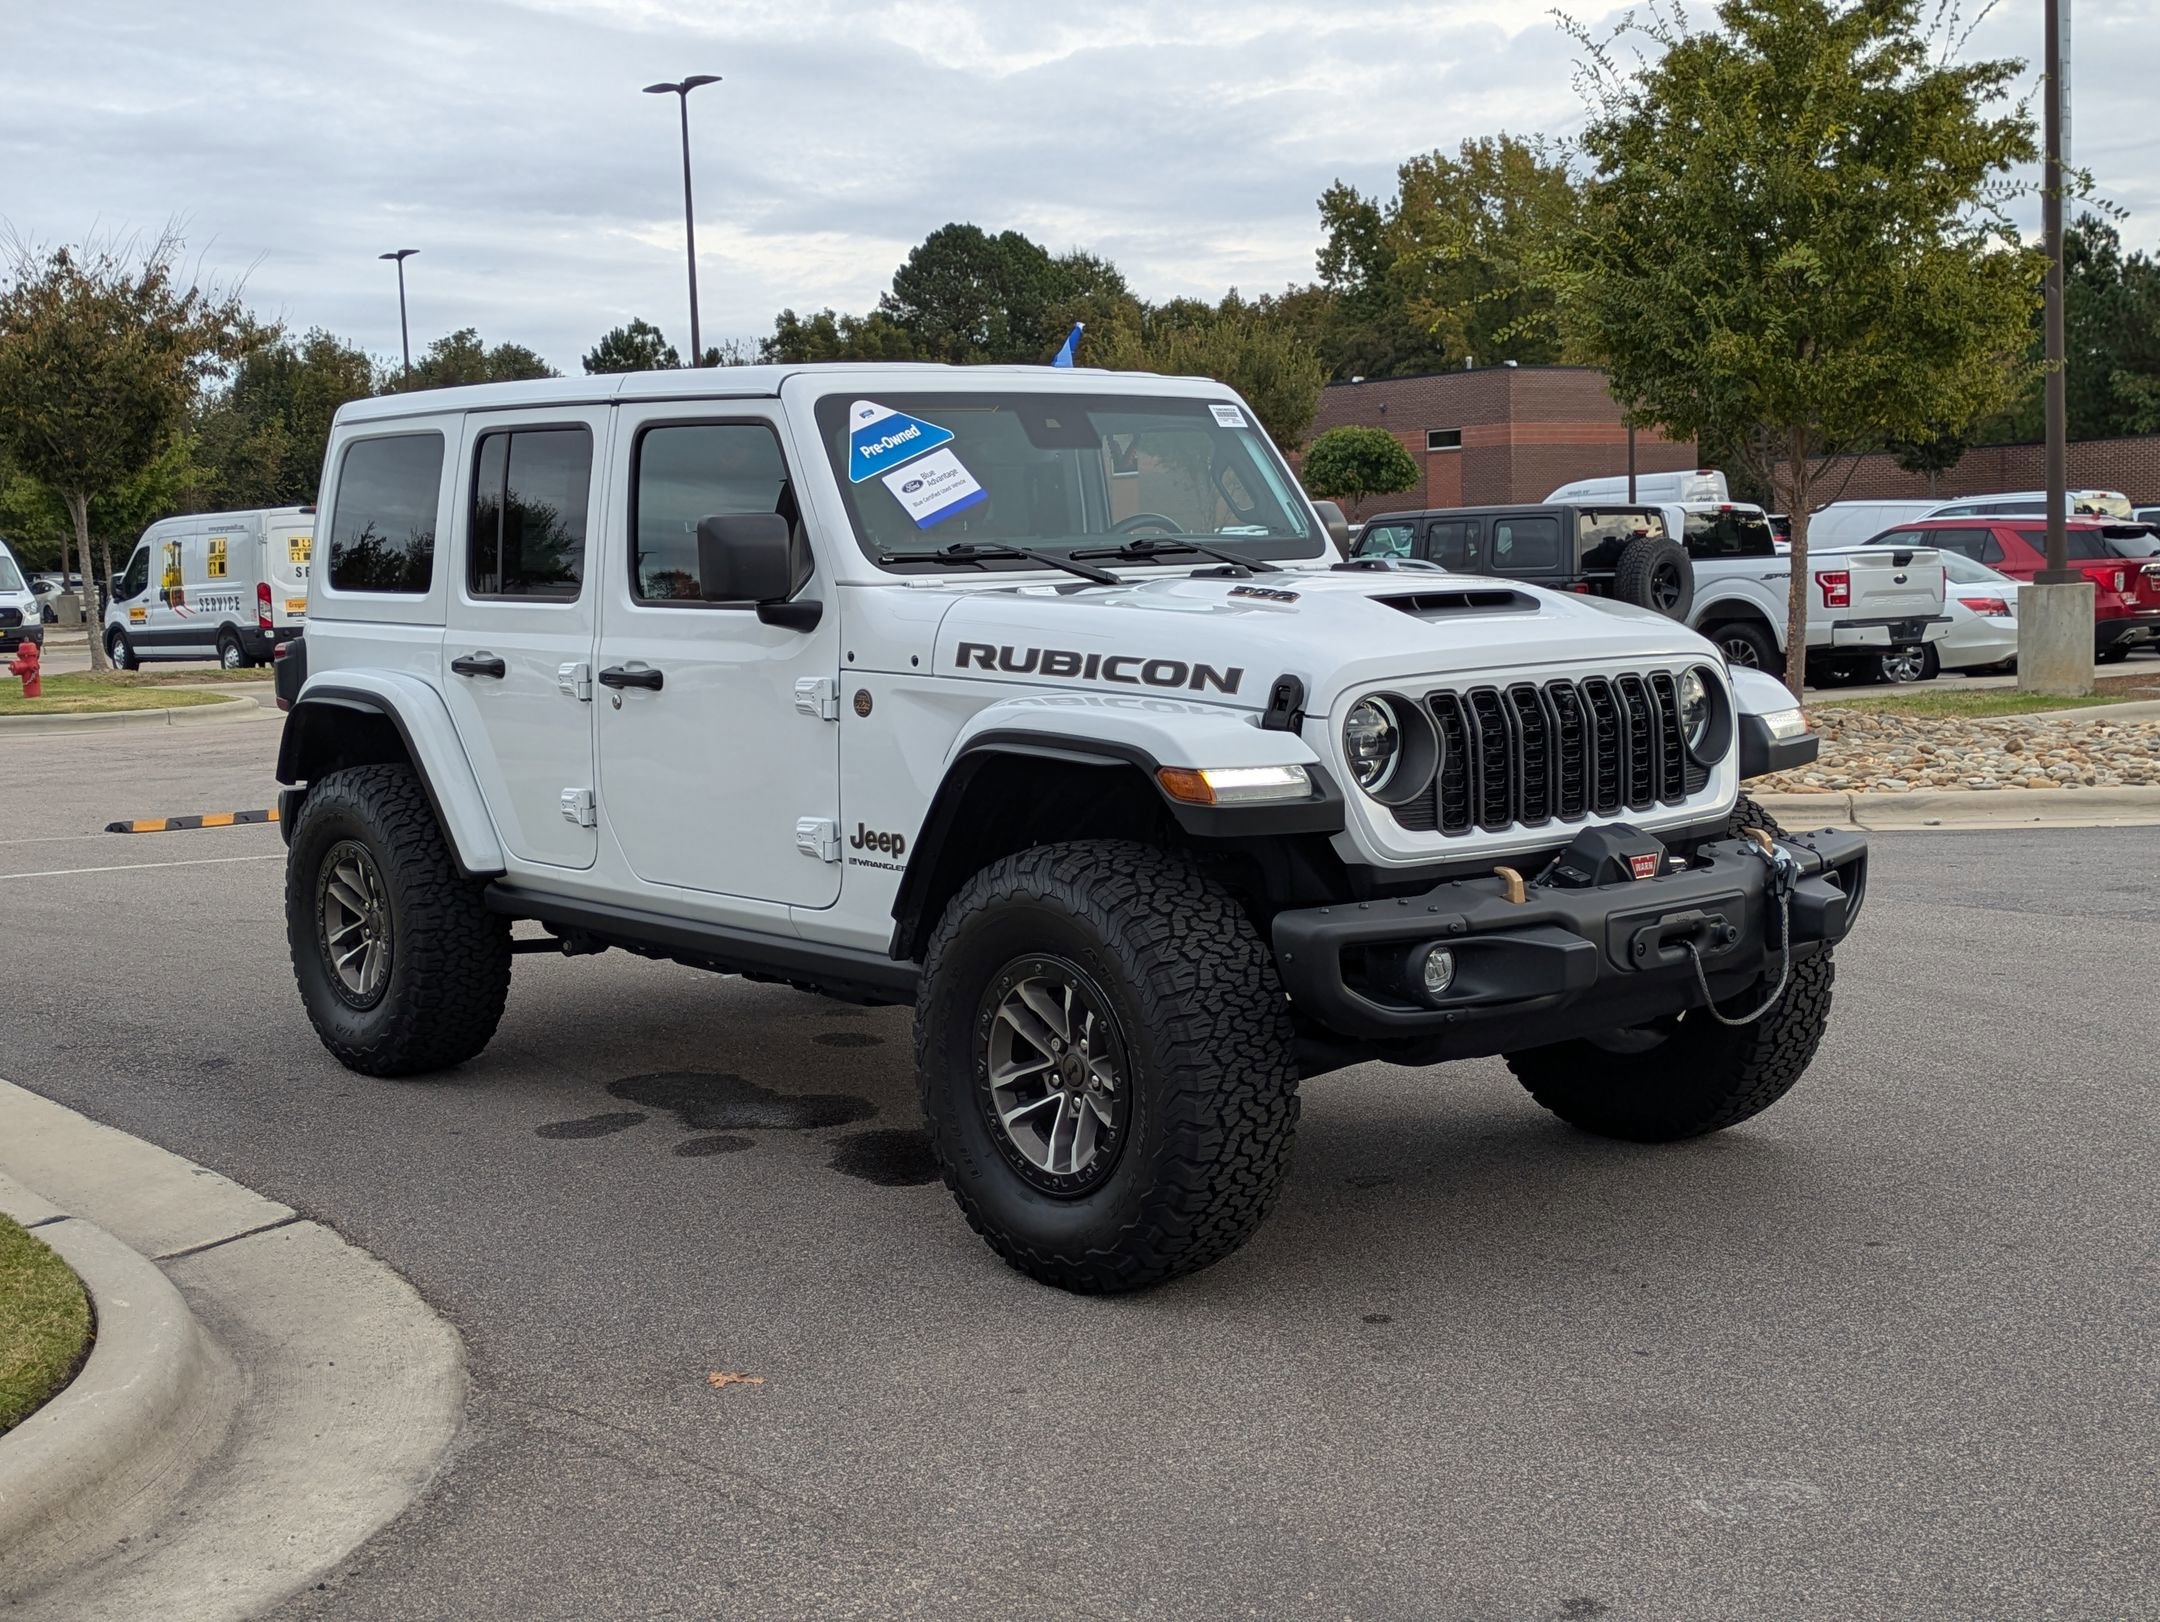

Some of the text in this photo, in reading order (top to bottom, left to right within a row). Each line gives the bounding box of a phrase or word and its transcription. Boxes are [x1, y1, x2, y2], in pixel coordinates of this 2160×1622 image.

[859, 423, 922, 459] Pre-Owned
[920, 469, 937, 480] Blue
[926, 468, 959, 487] Advantage
[199, 596, 240, 613] SERVICE
[955, 641, 1245, 695] RUBICON
[849, 821, 906, 860] Jeep
[1634, 861, 1654, 872] WARN
